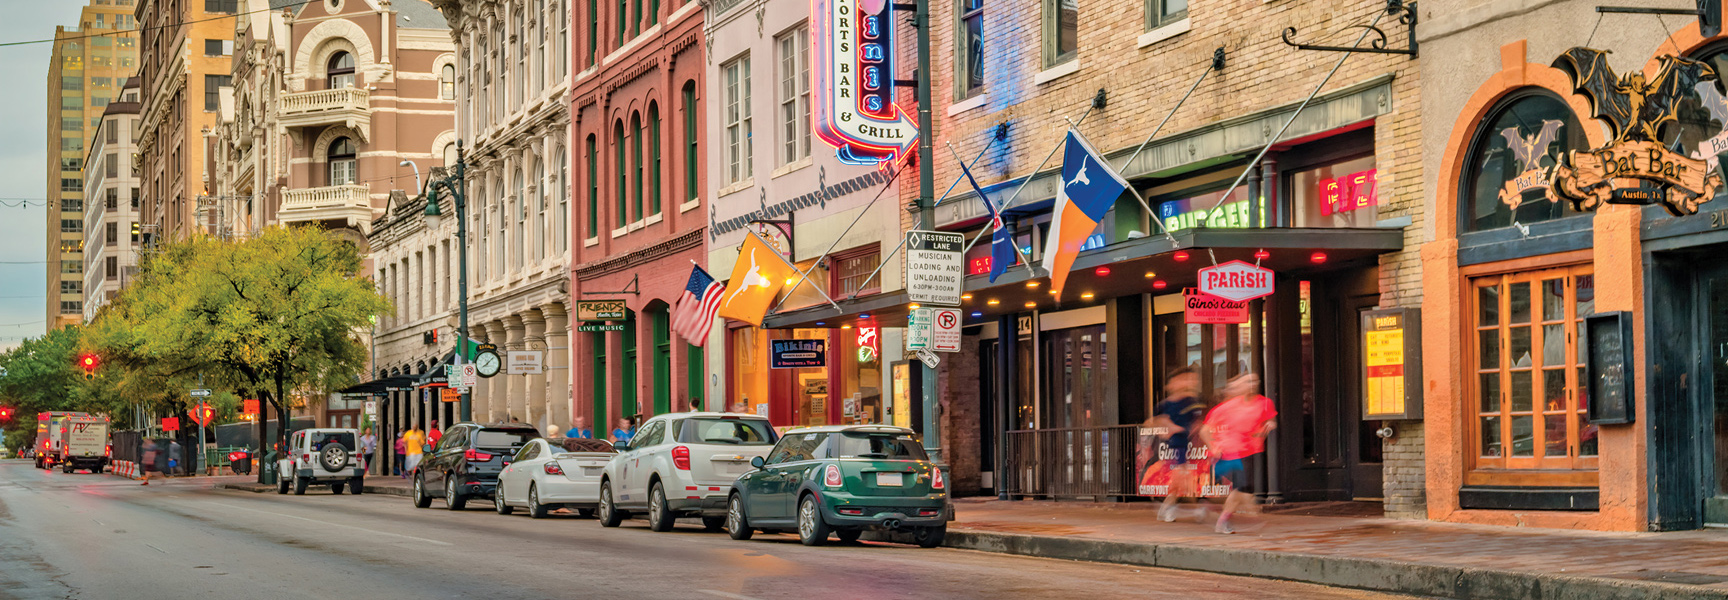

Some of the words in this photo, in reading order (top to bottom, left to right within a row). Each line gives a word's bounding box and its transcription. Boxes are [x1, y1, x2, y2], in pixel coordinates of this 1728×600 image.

[838, 0, 850, 52] ORTS
[839, 63, 850, 98] BAR
[840, 111, 852, 122] &
[858, 124, 904, 138] GRILL
[1600, 149, 1640, 176] Bat
[1645, 147, 1687, 180] Bar
[1515, 176, 1532, 192] Bat
[1535, 171, 1551, 187] Ba
[1711, 211, 1728, 229] 21
[921, 233, 962, 243] RESTRICTED
[918, 252, 952, 261] MUSICIAN
[909, 262, 941, 270] LOADING
[913, 273, 955, 283] UNLOADING
[931, 294, 958, 302] REQUIRED
[1188, 297, 1219, 309] Gino's
[579, 302, 624, 312] FRIENDS
[774, 341, 823, 354] Bikinis
[1185, 441, 1208, 460] East
[1139, 484, 1169, 496] CARRYOUT
[1201, 484, 1231, 496] DELIVERY
